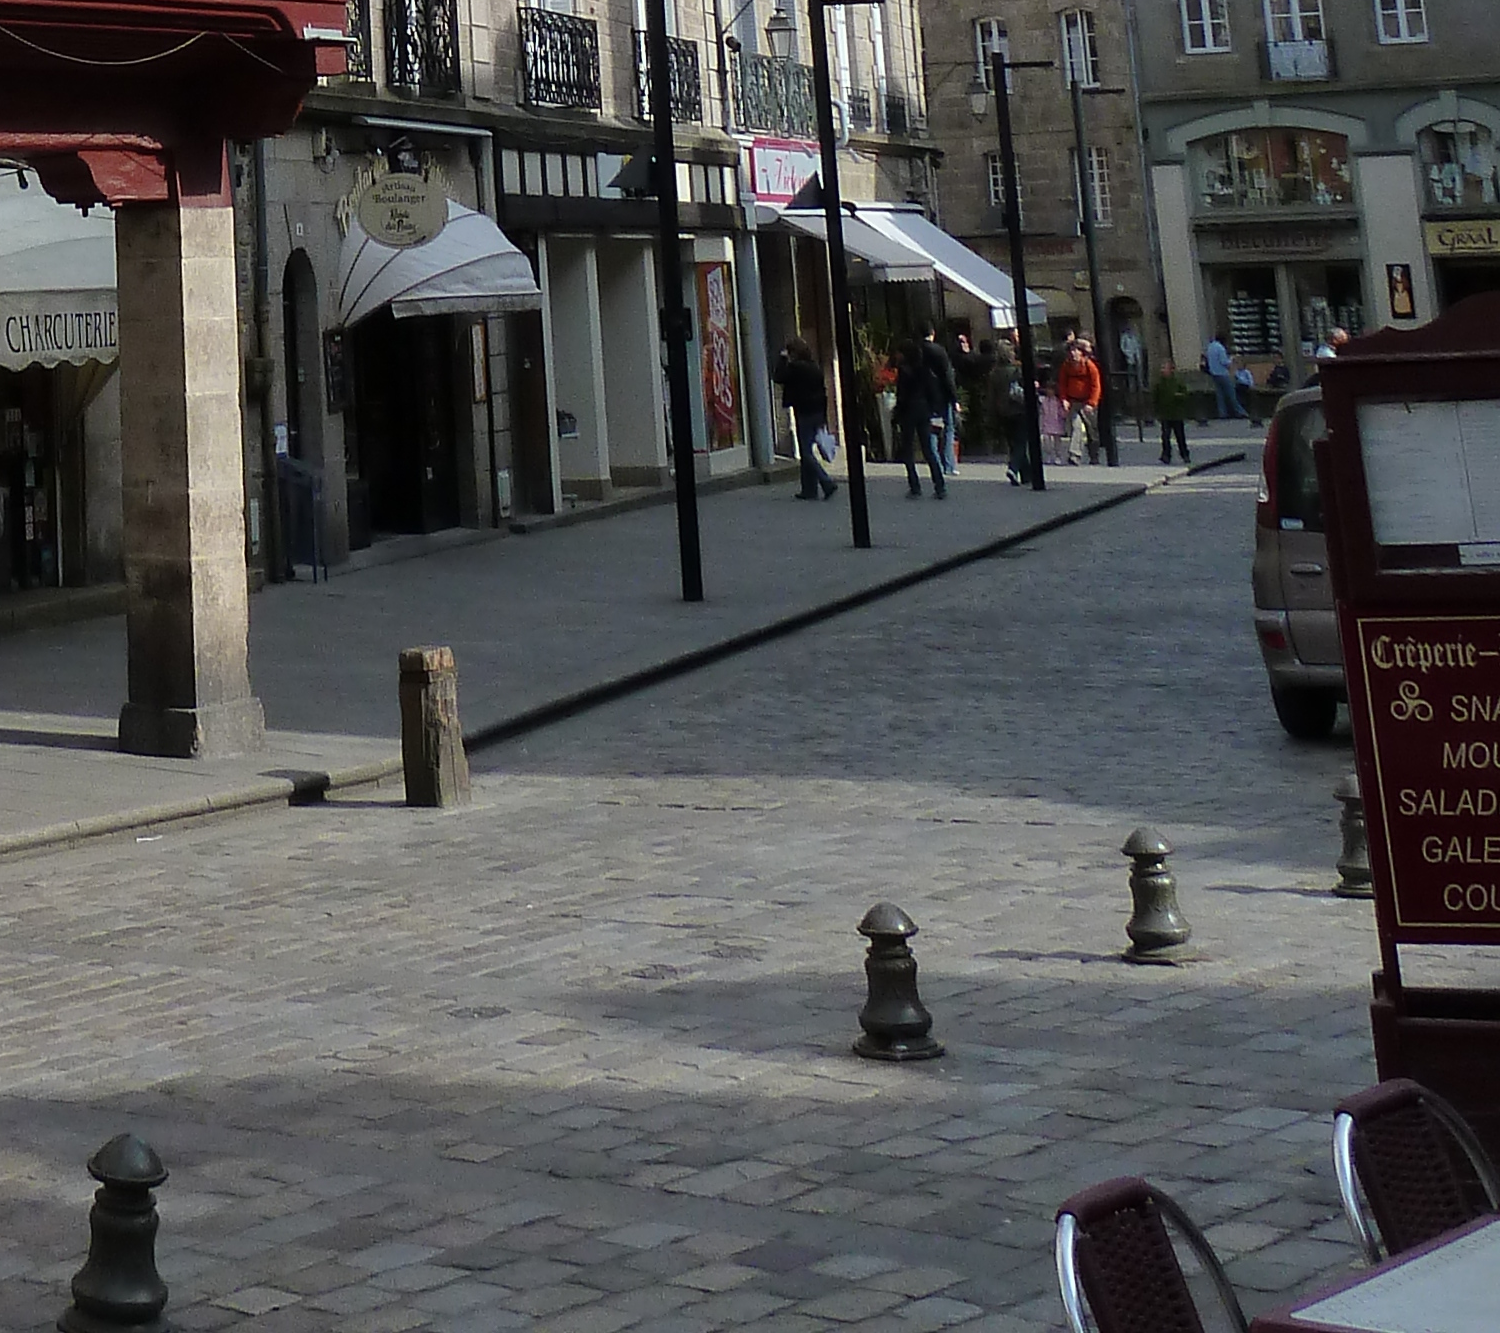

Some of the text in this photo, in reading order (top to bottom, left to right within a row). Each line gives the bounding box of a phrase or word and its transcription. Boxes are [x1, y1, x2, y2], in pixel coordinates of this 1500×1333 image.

[372, 194, 426, 205] Boulanger
[5, 311, 117, 353] CHARCUTERIE
[1422, 836, 1500, 863] GALE
